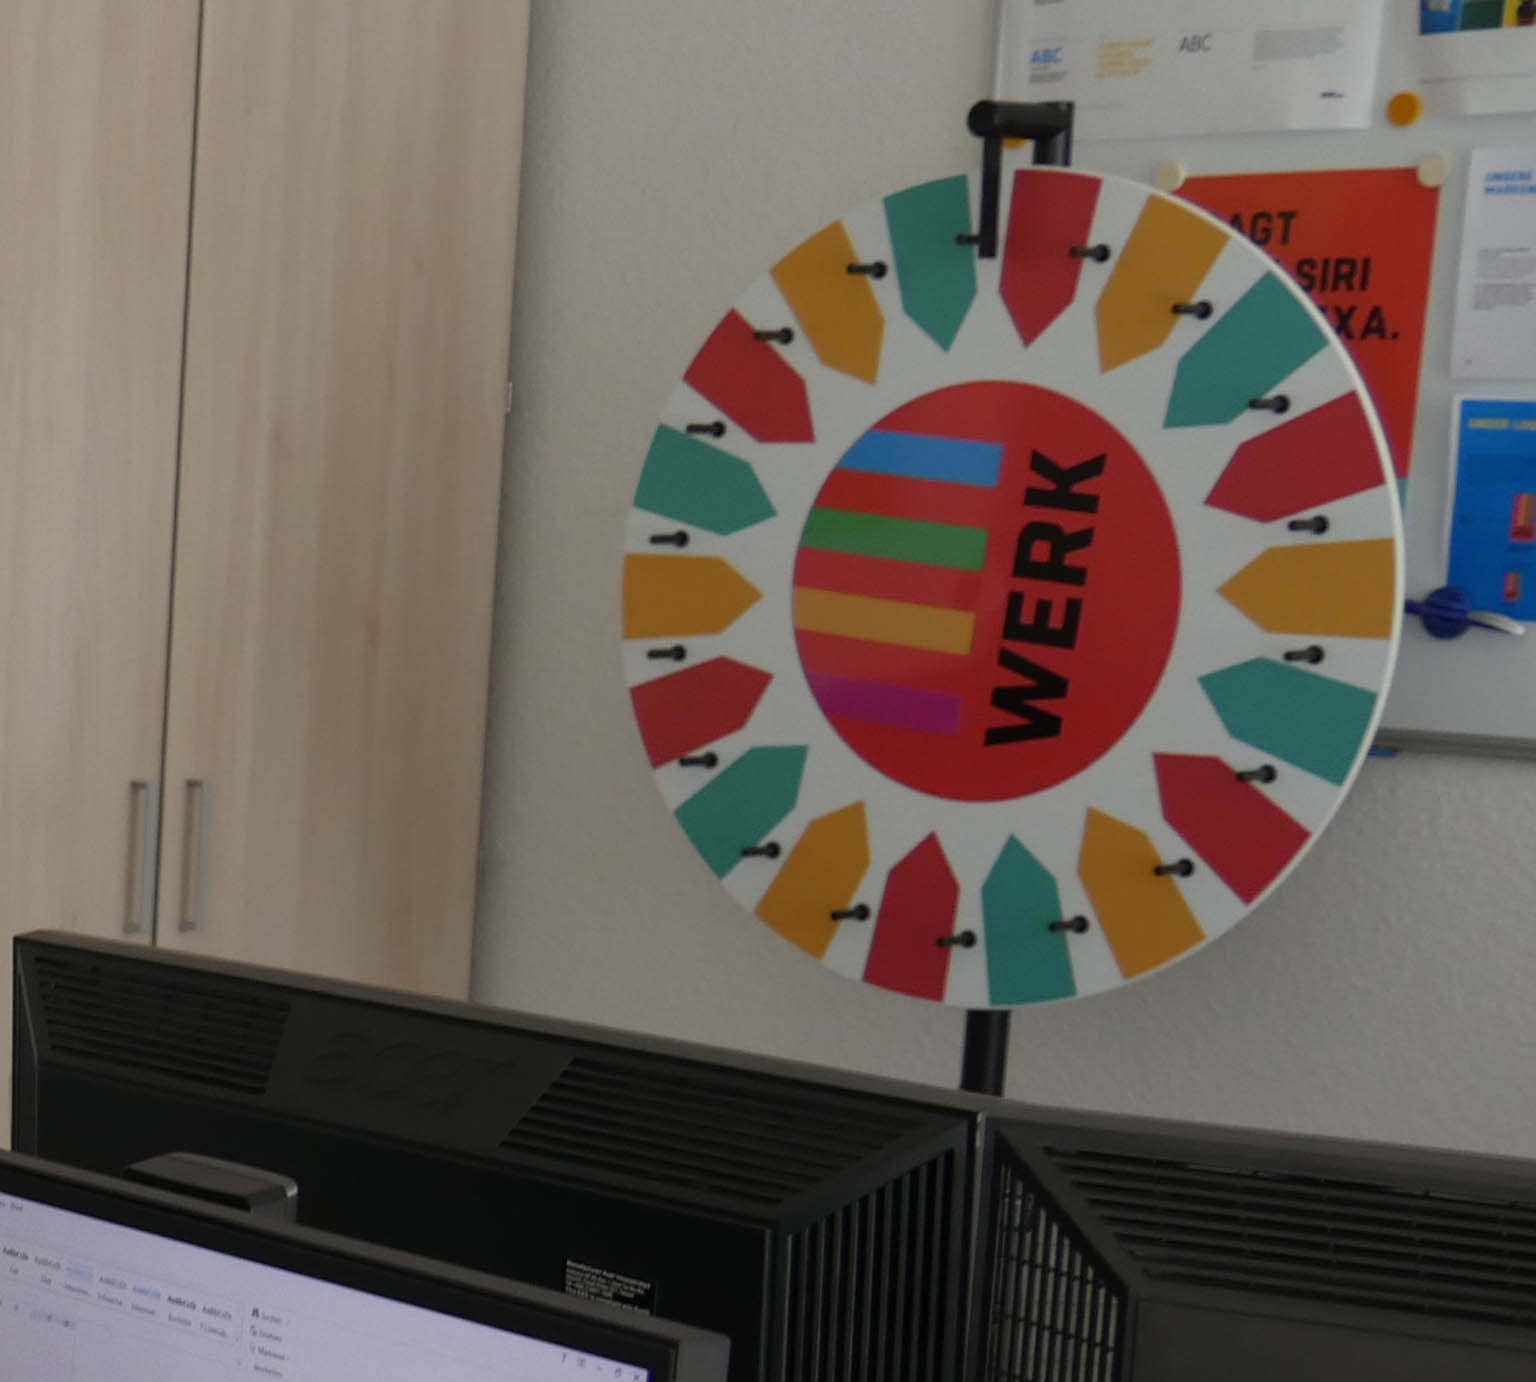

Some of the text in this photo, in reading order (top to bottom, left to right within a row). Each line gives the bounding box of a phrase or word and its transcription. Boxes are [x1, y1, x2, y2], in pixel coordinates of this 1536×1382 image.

[1295, 256, 1372, 293] SIRI
[1319, 305, 1401, 341] XA.
[983, 449, 1107, 748] WERK
